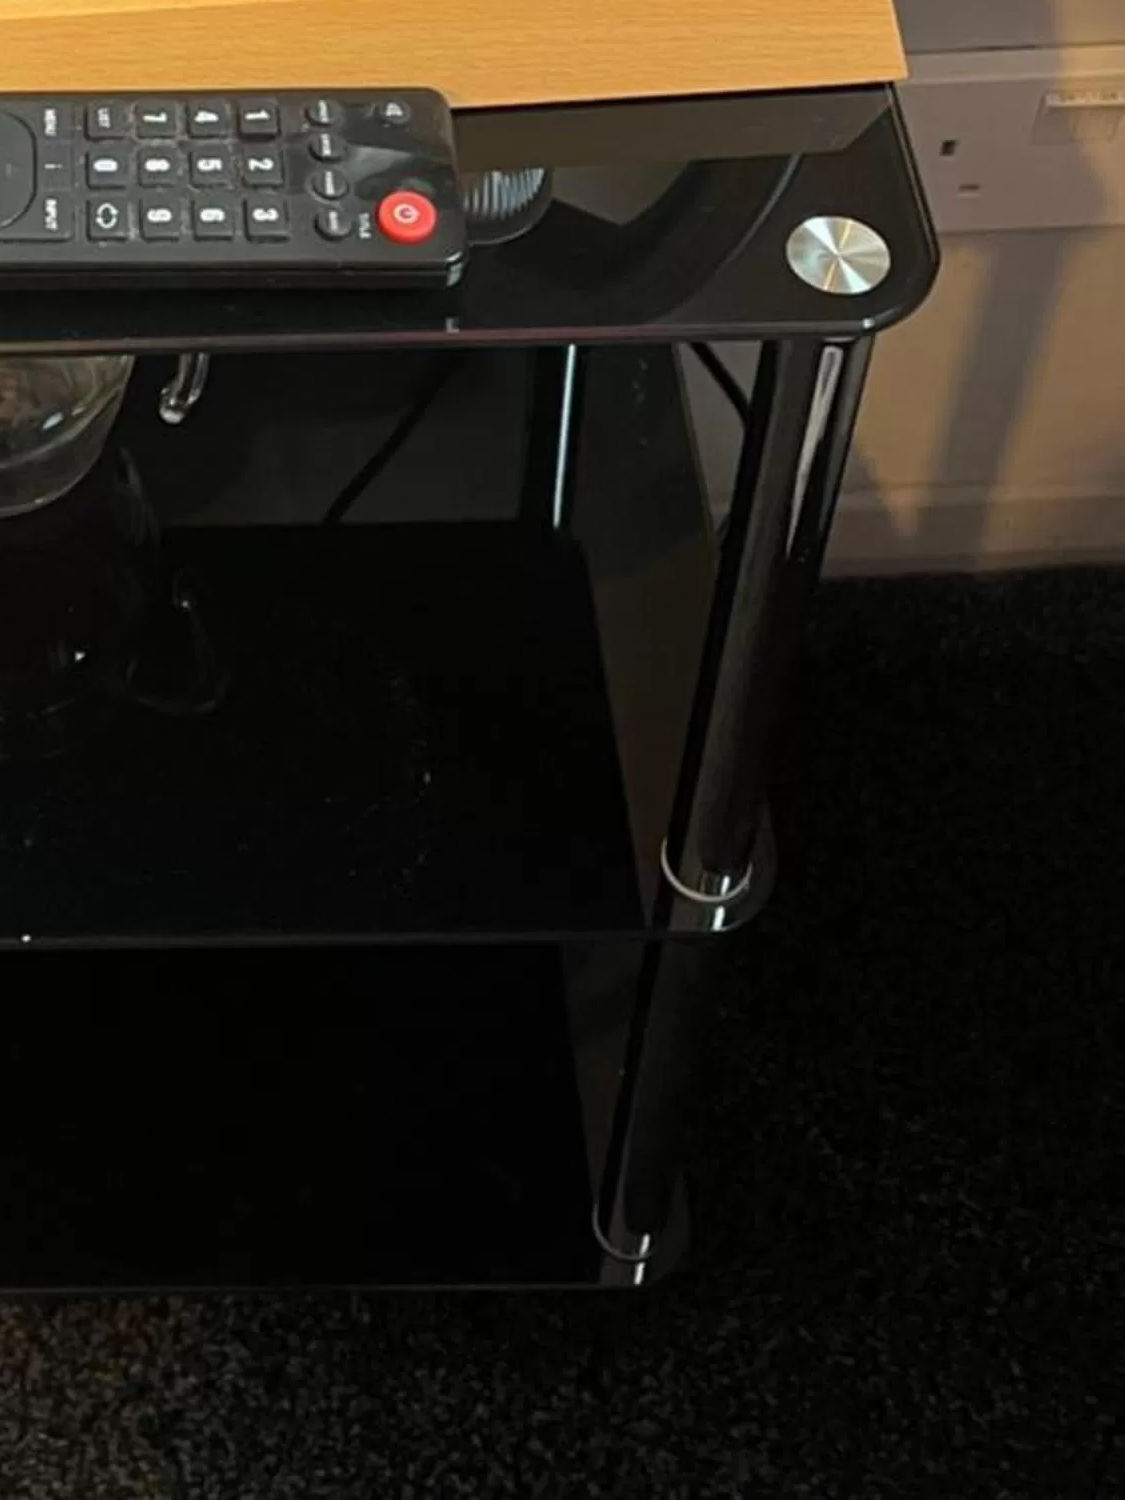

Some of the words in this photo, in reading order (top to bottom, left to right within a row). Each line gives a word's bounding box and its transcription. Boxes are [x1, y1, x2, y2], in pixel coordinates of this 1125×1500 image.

[142, 111, 168, 124] 7
[193, 110, 219, 124] 4
[244, 110, 270, 122] 1
[92, 158, 118, 173] 0
[144, 158, 170, 172] 8
[197, 158, 223, 172] 5
[248, 158, 275, 172] 2
[146, 208, 173, 223] 9
[198, 208, 226, 223] 6
[252, 208, 279, 223] 3
